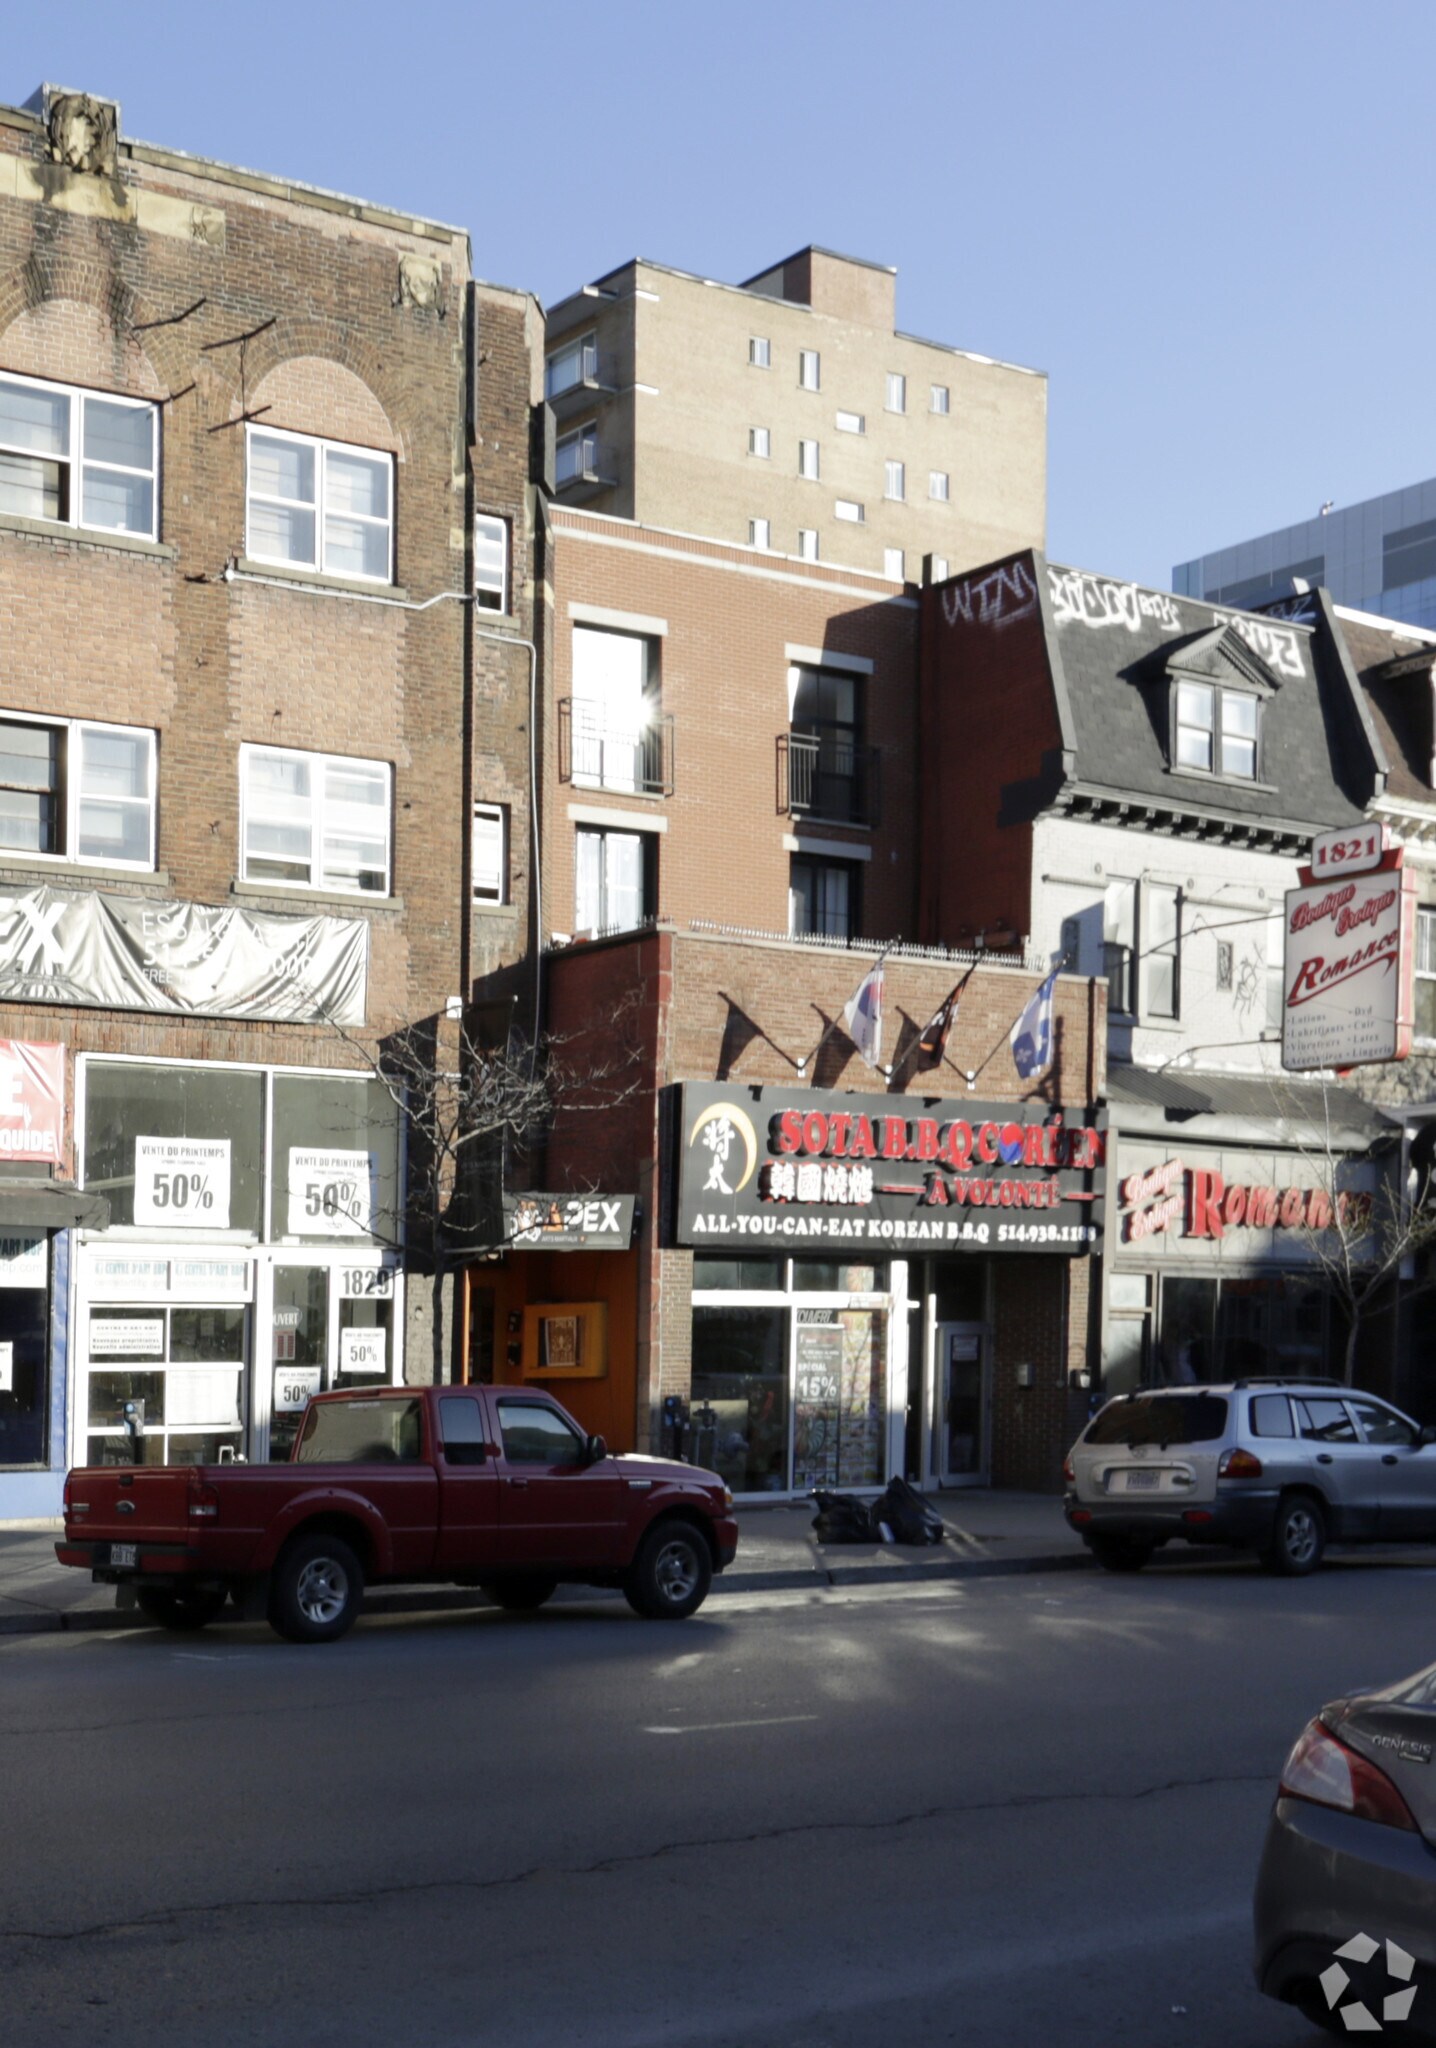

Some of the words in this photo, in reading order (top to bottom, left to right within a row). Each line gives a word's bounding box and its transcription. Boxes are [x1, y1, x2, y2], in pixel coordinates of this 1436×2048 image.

[1317, 836, 1375, 866] 1821
[1290, 883, 1356, 934] Boutique
[1287, 928, 1399, 1001] Romance
[779, 1110, 877, 1157] SOTA
[142, 1145, 165, 1156] VENTE
[167, 1146, 179, 1157] DU
[180, 1146, 225, 1158] PRINTEMPS
[295, 1156, 317, 1167] VENTE
[319, 1157, 330, 1168] DU
[331, 1157, 373, 1170] PRINTEMPS
[152, 1173, 214, 1209] 50%
[305, 1182, 361, 1218] 50%
[928, 1169, 948, 1205] À
[953, 1174, 1061, 1208] VOLONTÉ
[867, 1219, 944, 1239] KOREAN
[350, 1345, 377, 1363] 50%
[283, 1384, 312, 1402] 50%
[799, 1375, 837, 1398] 15%
[1372, 1734, 1432, 1755] GENESIS
